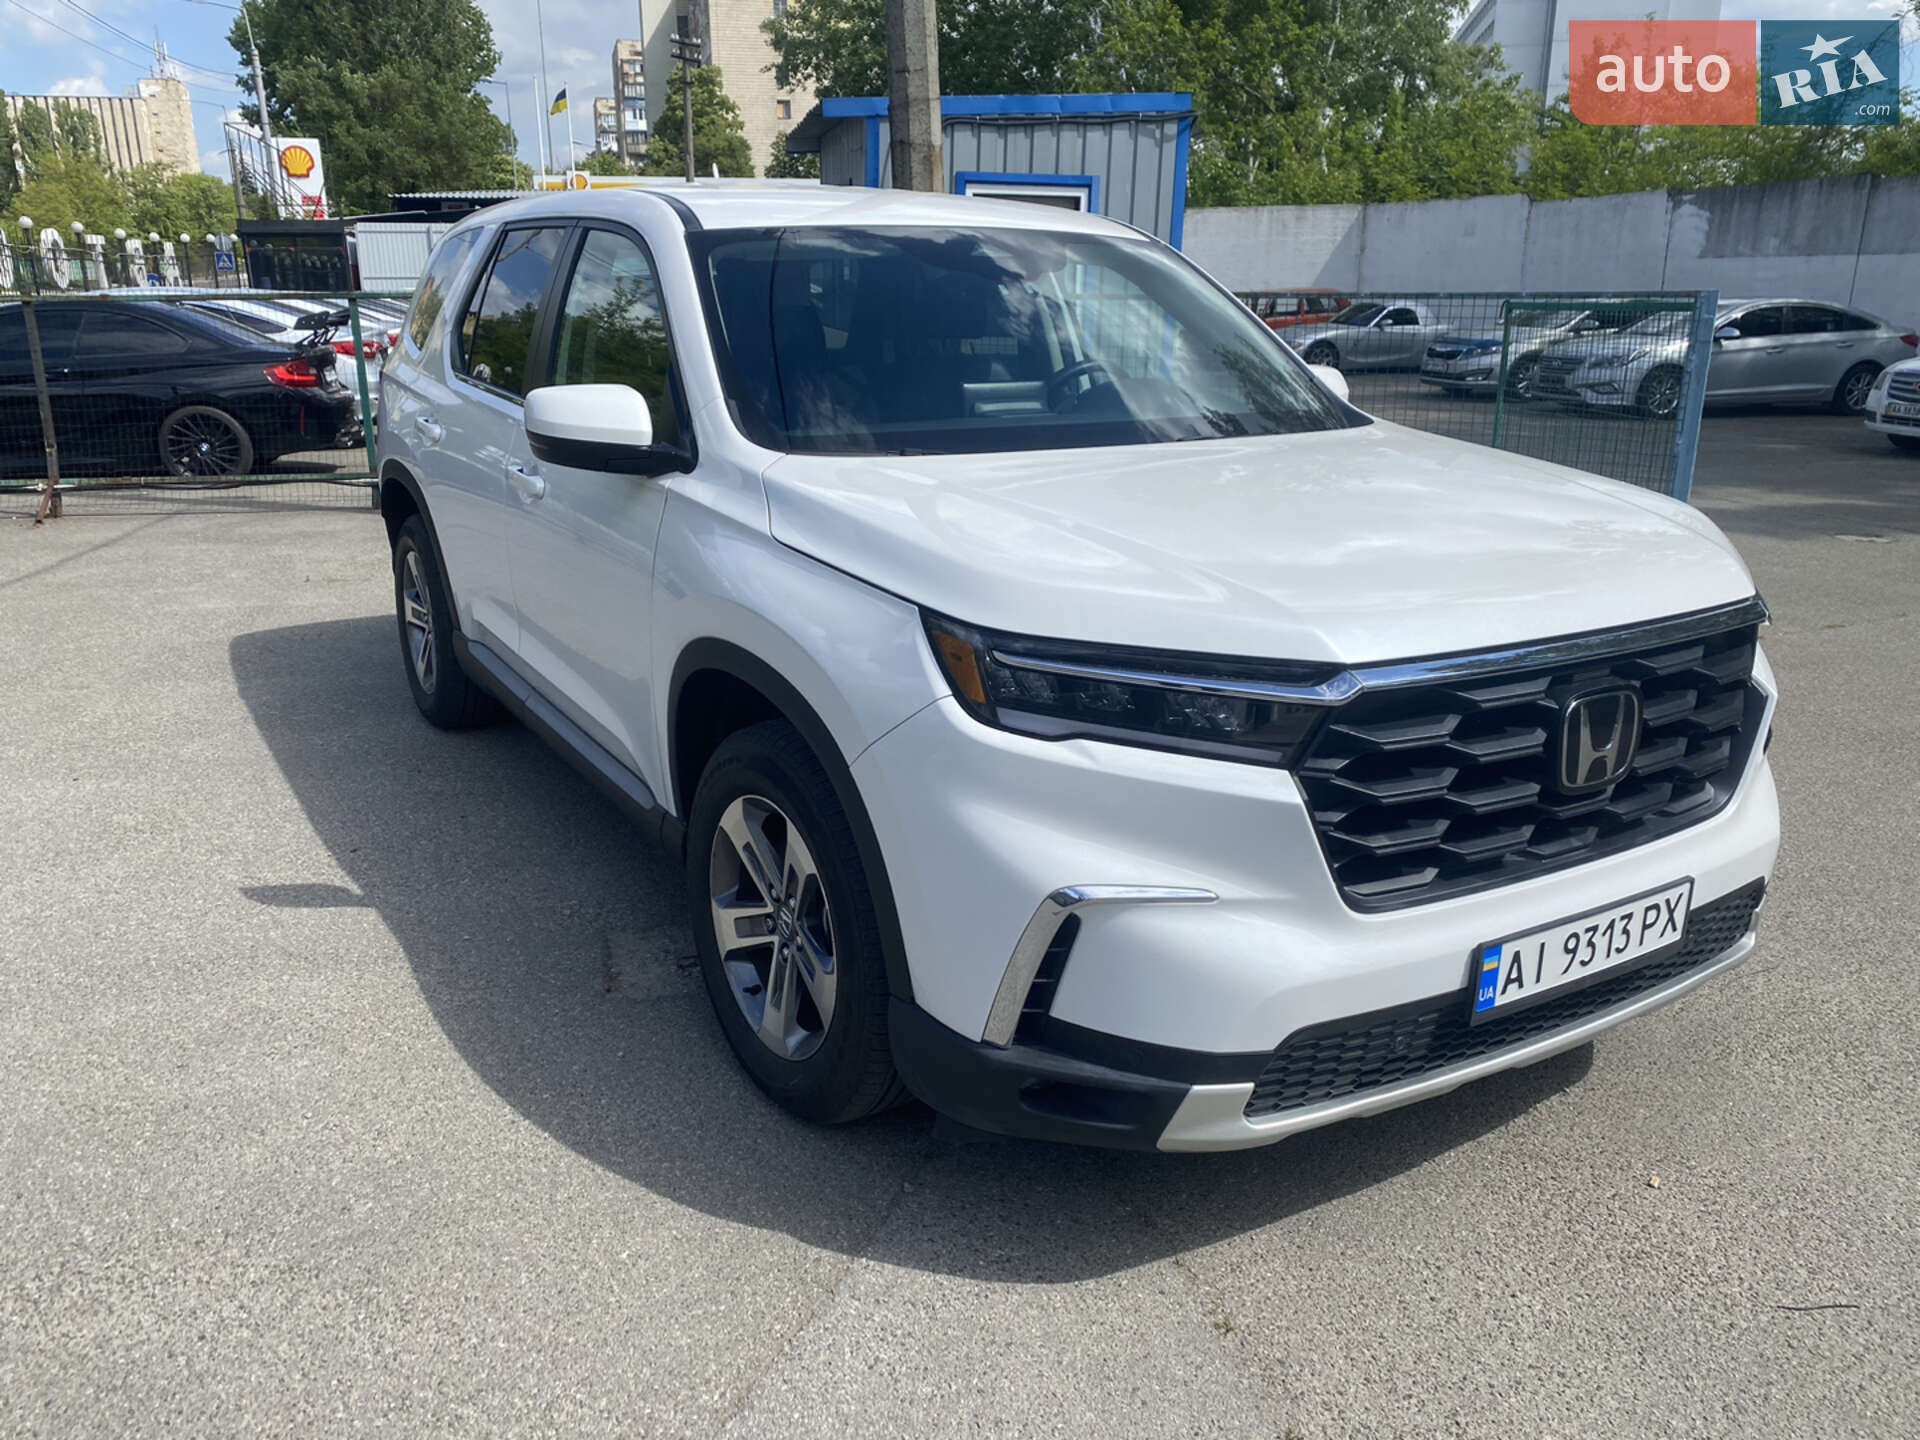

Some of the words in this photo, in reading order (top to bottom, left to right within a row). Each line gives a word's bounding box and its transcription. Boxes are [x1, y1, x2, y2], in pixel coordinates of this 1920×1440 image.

[1500, 942, 1545, 995] AI
[1560, 911, 1633, 975] 9313
[1639, 892, 1683, 947] PX
[1479, 986, 1495, 1001] UA
